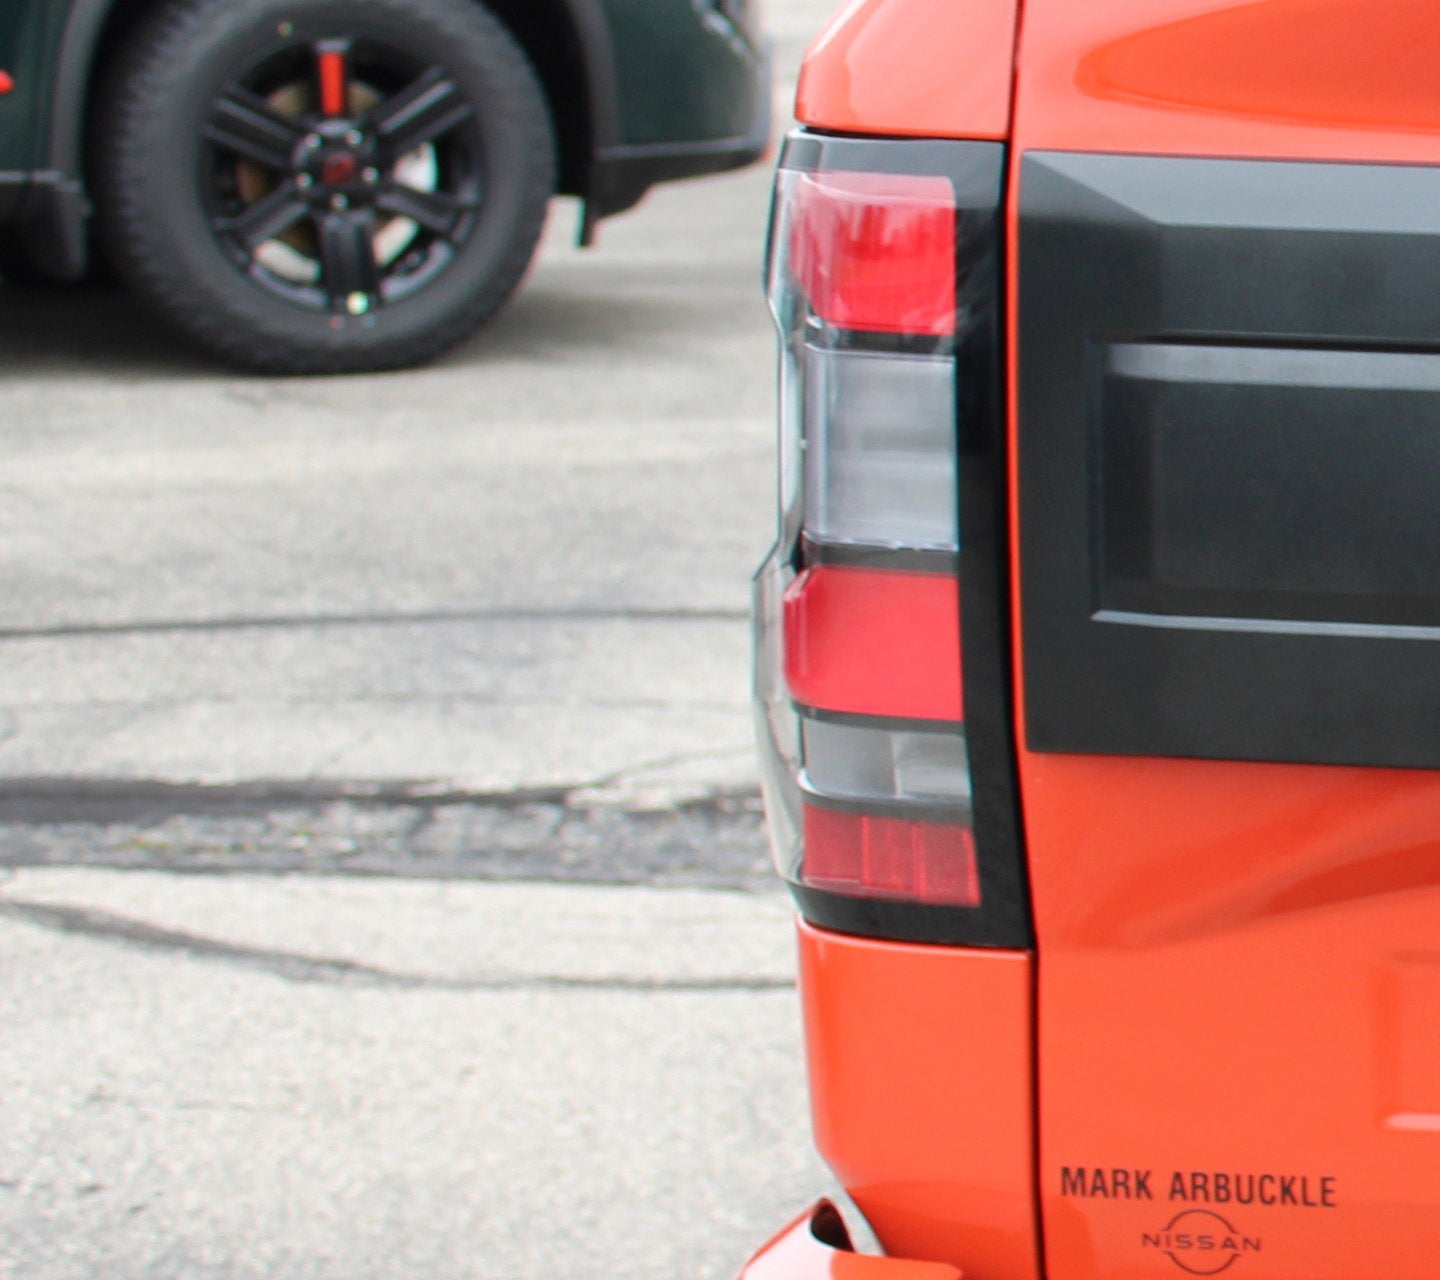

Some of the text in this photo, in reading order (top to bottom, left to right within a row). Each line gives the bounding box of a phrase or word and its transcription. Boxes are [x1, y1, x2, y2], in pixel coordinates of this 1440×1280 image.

[1061, 1166, 1337, 1208] MARK ARBUCKLE
[1141, 1232, 1261, 1251] NISSAN
